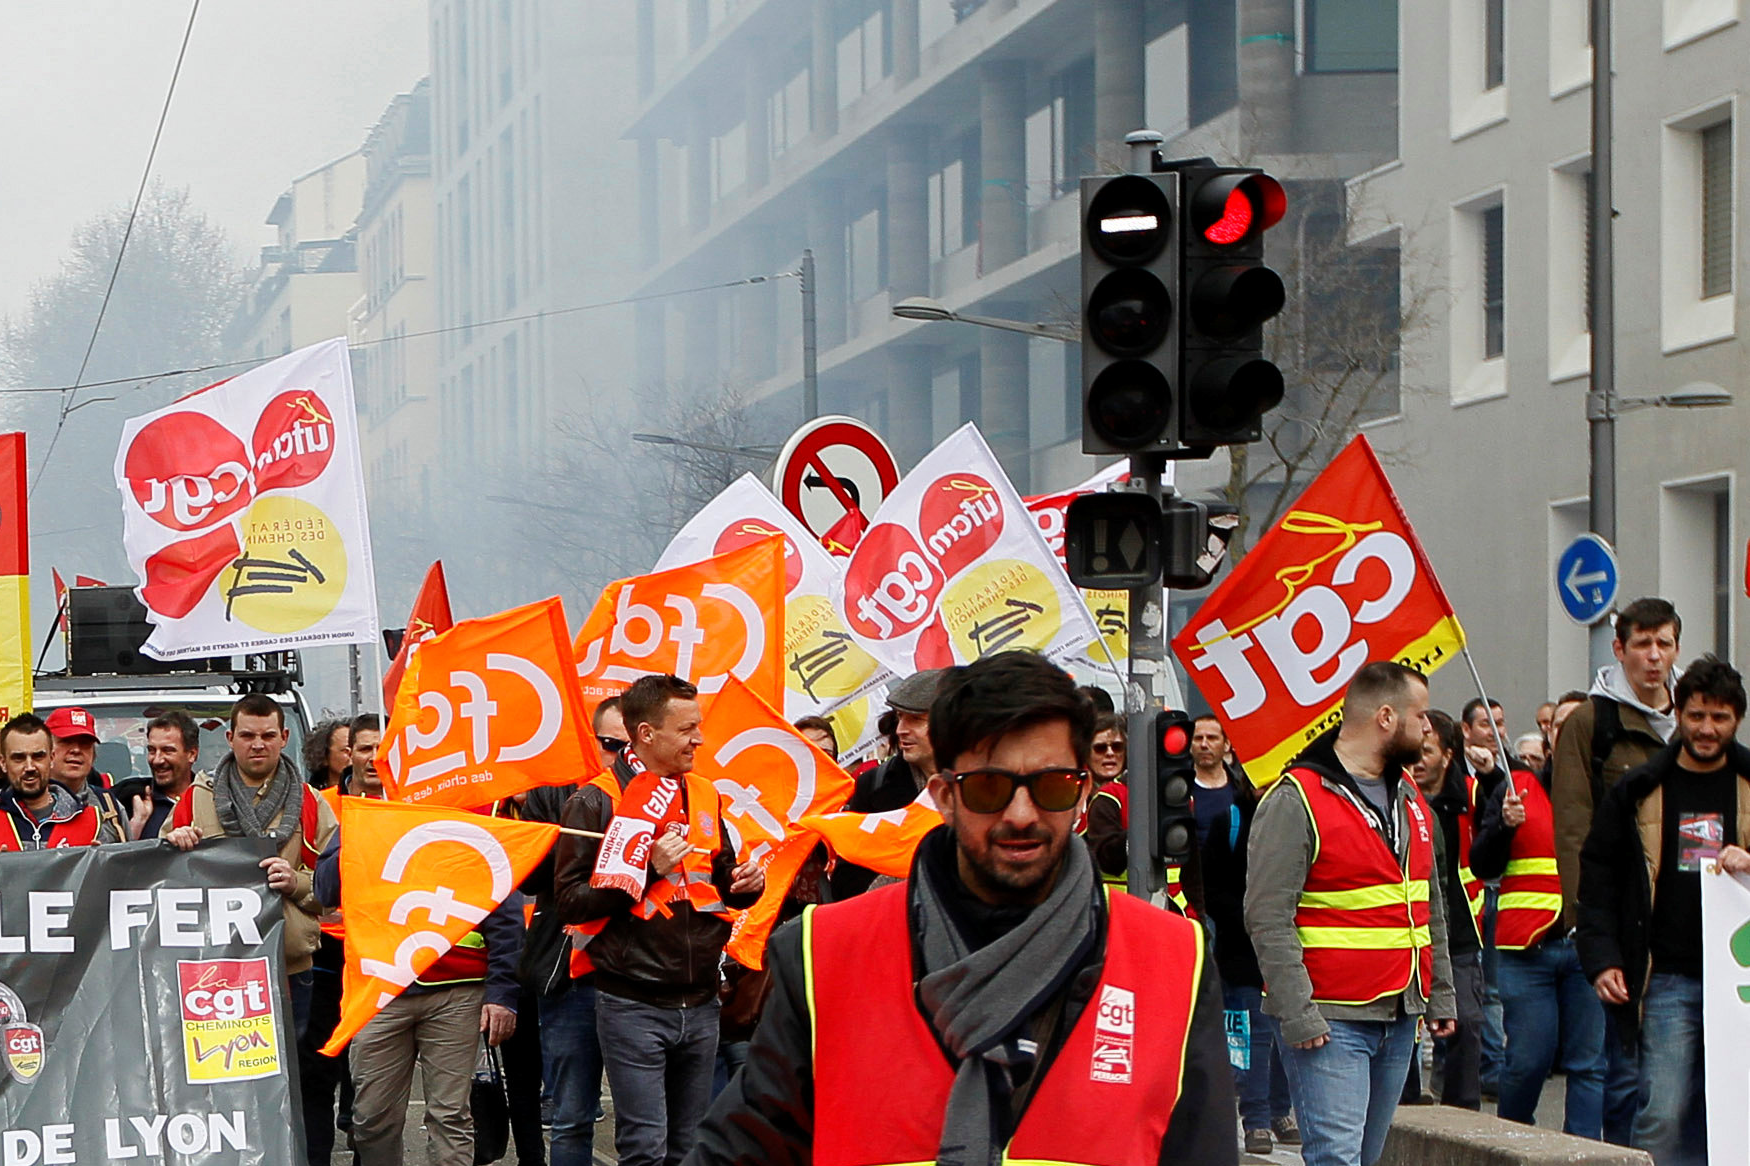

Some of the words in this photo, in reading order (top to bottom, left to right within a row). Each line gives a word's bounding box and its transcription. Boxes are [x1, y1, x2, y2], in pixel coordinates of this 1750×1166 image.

[599, 821, 622, 869] CHEMINOTS
[109, 887, 264, 951] FER
[184, 980, 266, 1020] cgt
[1099, 1001, 1134, 1027] cgt
[186, 1015, 271, 1031] CHEMINOTS
[9, 1034, 40, 1053] cgt
[192, 1030, 269, 1070] Lyon
[238, 1055, 277, 1068] REGION
[105, 1110, 247, 1160] LYON
